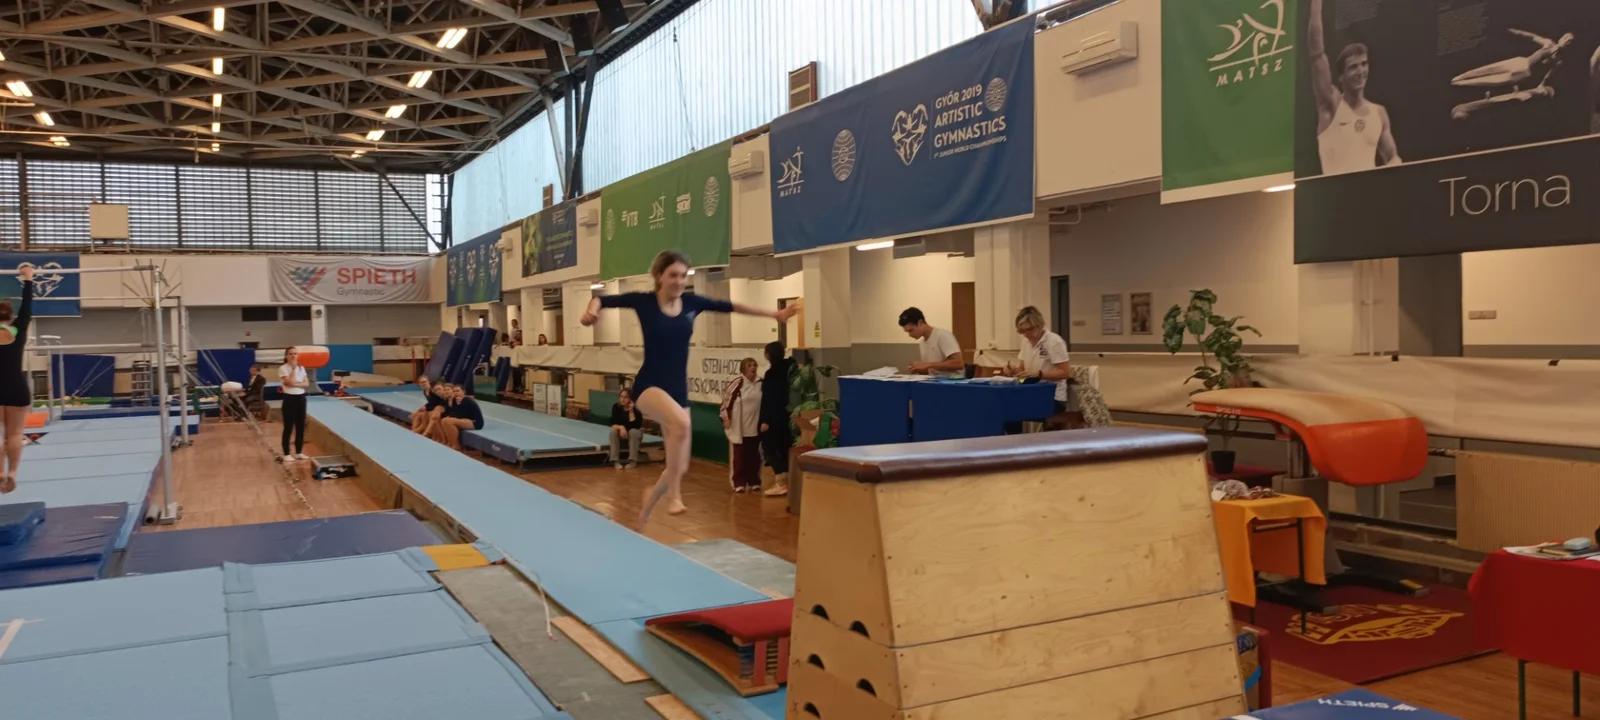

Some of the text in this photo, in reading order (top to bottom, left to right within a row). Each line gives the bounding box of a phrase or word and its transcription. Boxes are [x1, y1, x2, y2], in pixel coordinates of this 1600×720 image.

[1215, 58, 1284, 88] MATSZ
[961, 83, 983, 102] 2019
[934, 101, 983, 129] ARTISTIC
[934, 115, 1007, 148] GYMNASTICS
[1438, 175, 1570, 217] Torna
[337, 267, 417, 285] SPIETH
[337, 286, 385, 297] Gymnastic
[702, 358, 722, 374] ISTEN
[1317, 698, 1390, 709] SPIETH
